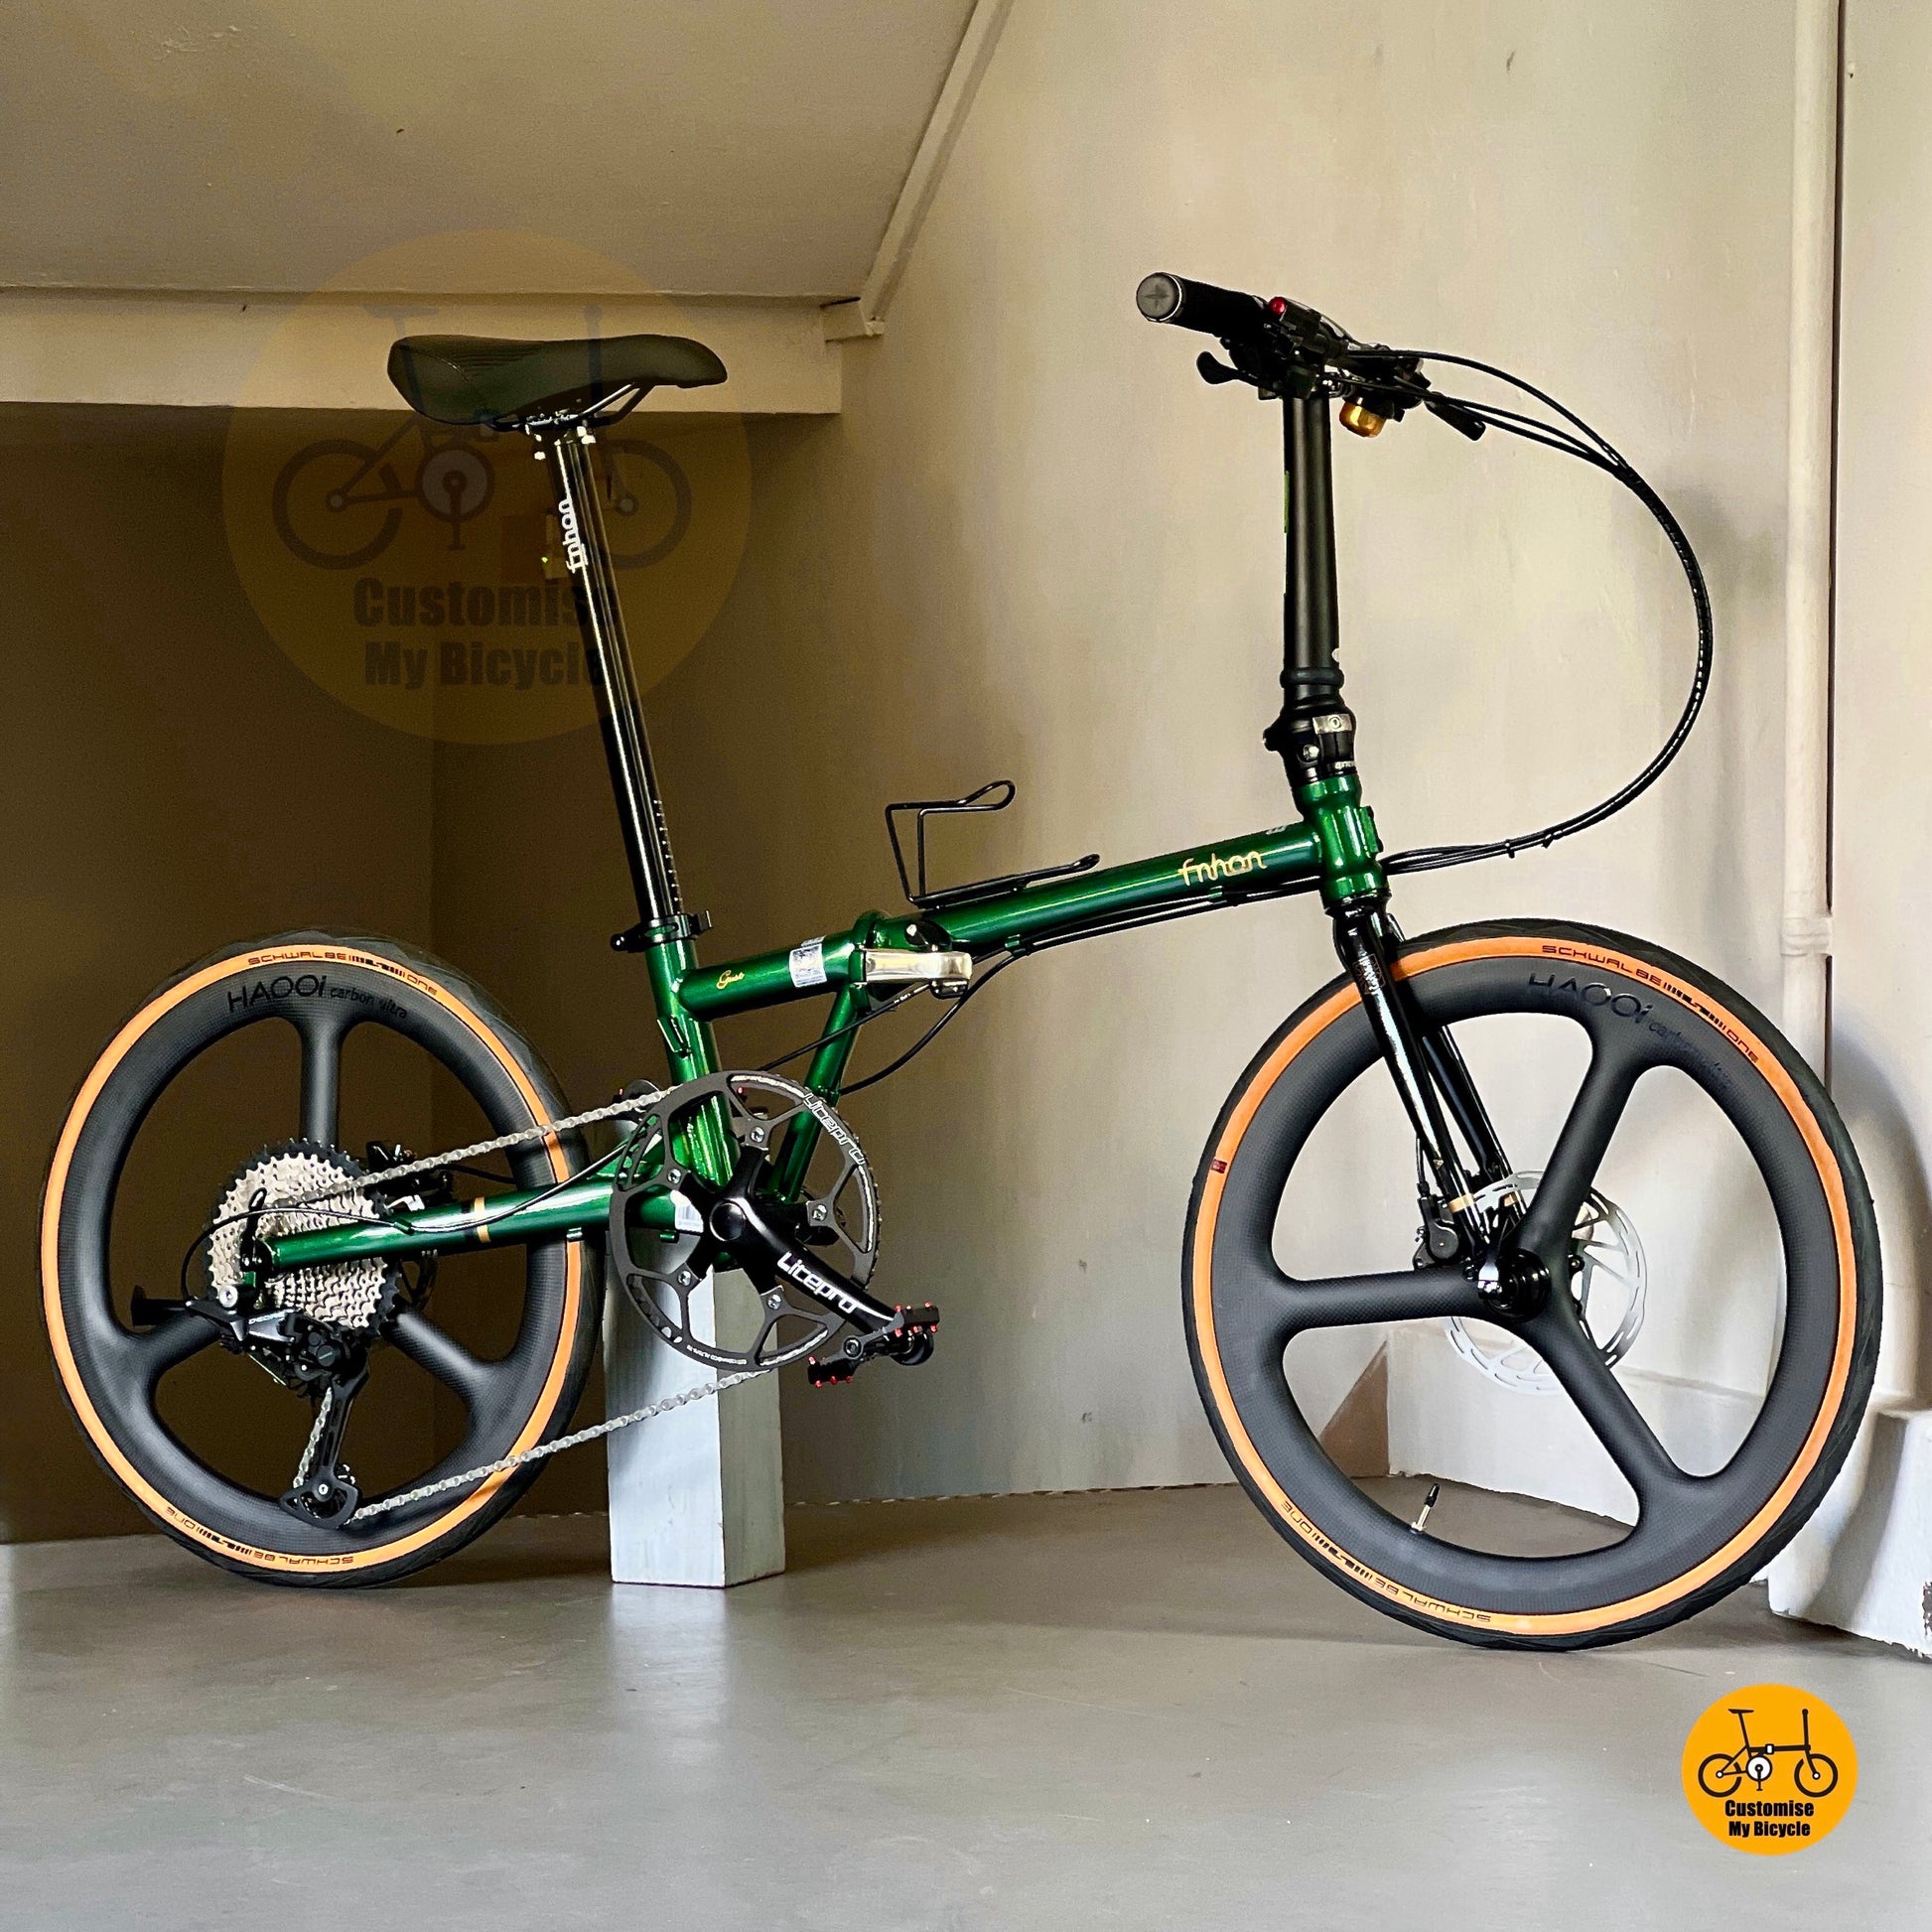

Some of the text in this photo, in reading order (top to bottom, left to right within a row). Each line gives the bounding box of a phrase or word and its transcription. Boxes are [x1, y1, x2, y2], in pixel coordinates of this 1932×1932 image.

[558, 498, 589, 574] fnhon
[1177, 851, 1268, 887] fnhon
[247, 950, 346, 966] SCHWALBE
[1542, 944, 1662, 986] SCHWALBE
[330, 986, 374, 1005] carbon
[777, 1251, 860, 1314] Litepro
